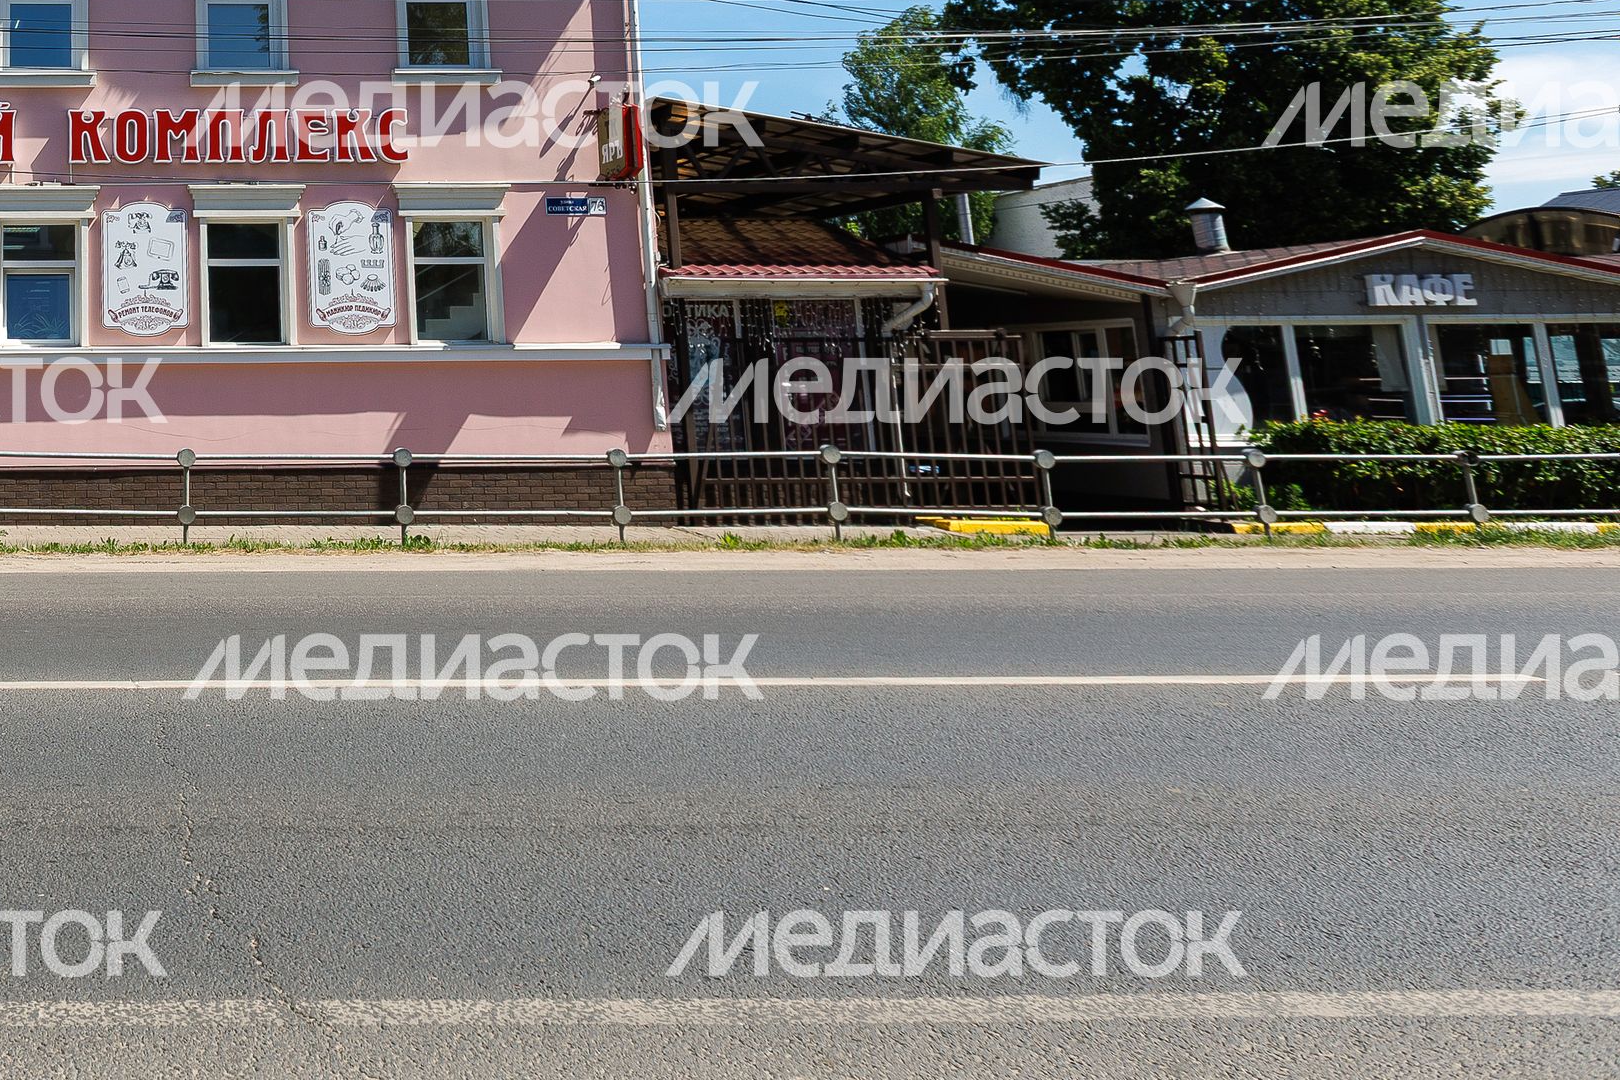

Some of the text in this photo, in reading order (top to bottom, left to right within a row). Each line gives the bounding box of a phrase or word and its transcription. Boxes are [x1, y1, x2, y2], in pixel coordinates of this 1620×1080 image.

[68, 107, 410, 165] КОМПЛЕКС
[601, 139, 624, 165] ЯРЪ
[1364, 273, 1479, 307] КАФЕ
[118, 305, 174, 319] РЕМОНТ ТЕЛЕФОНОВ
[326, 304, 382, 318] МАНИКЮР ПЕДИКЮР
